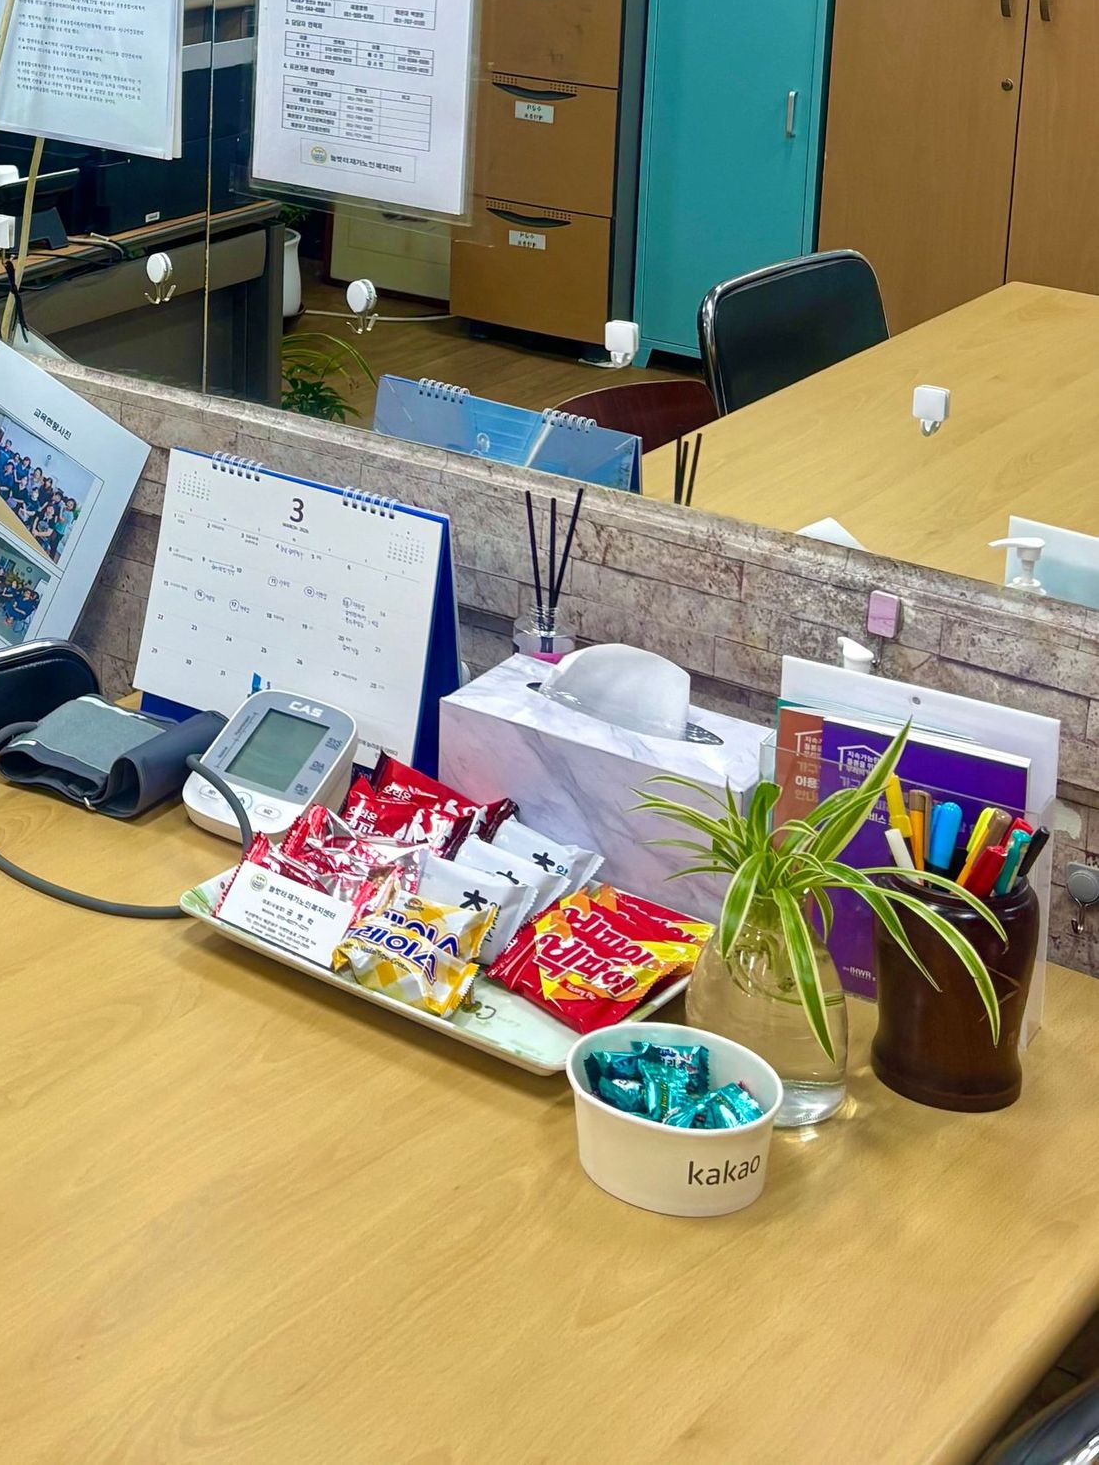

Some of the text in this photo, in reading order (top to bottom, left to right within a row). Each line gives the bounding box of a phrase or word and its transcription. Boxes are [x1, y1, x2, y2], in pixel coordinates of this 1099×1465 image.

[289, 497, 305, 523] 3
[288, 700, 323, 718] CAS
[382, 783, 412, 801] 오리온
[533, 934, 638, 998] 빅파이
[687, 1154, 761, 1186] kakao
